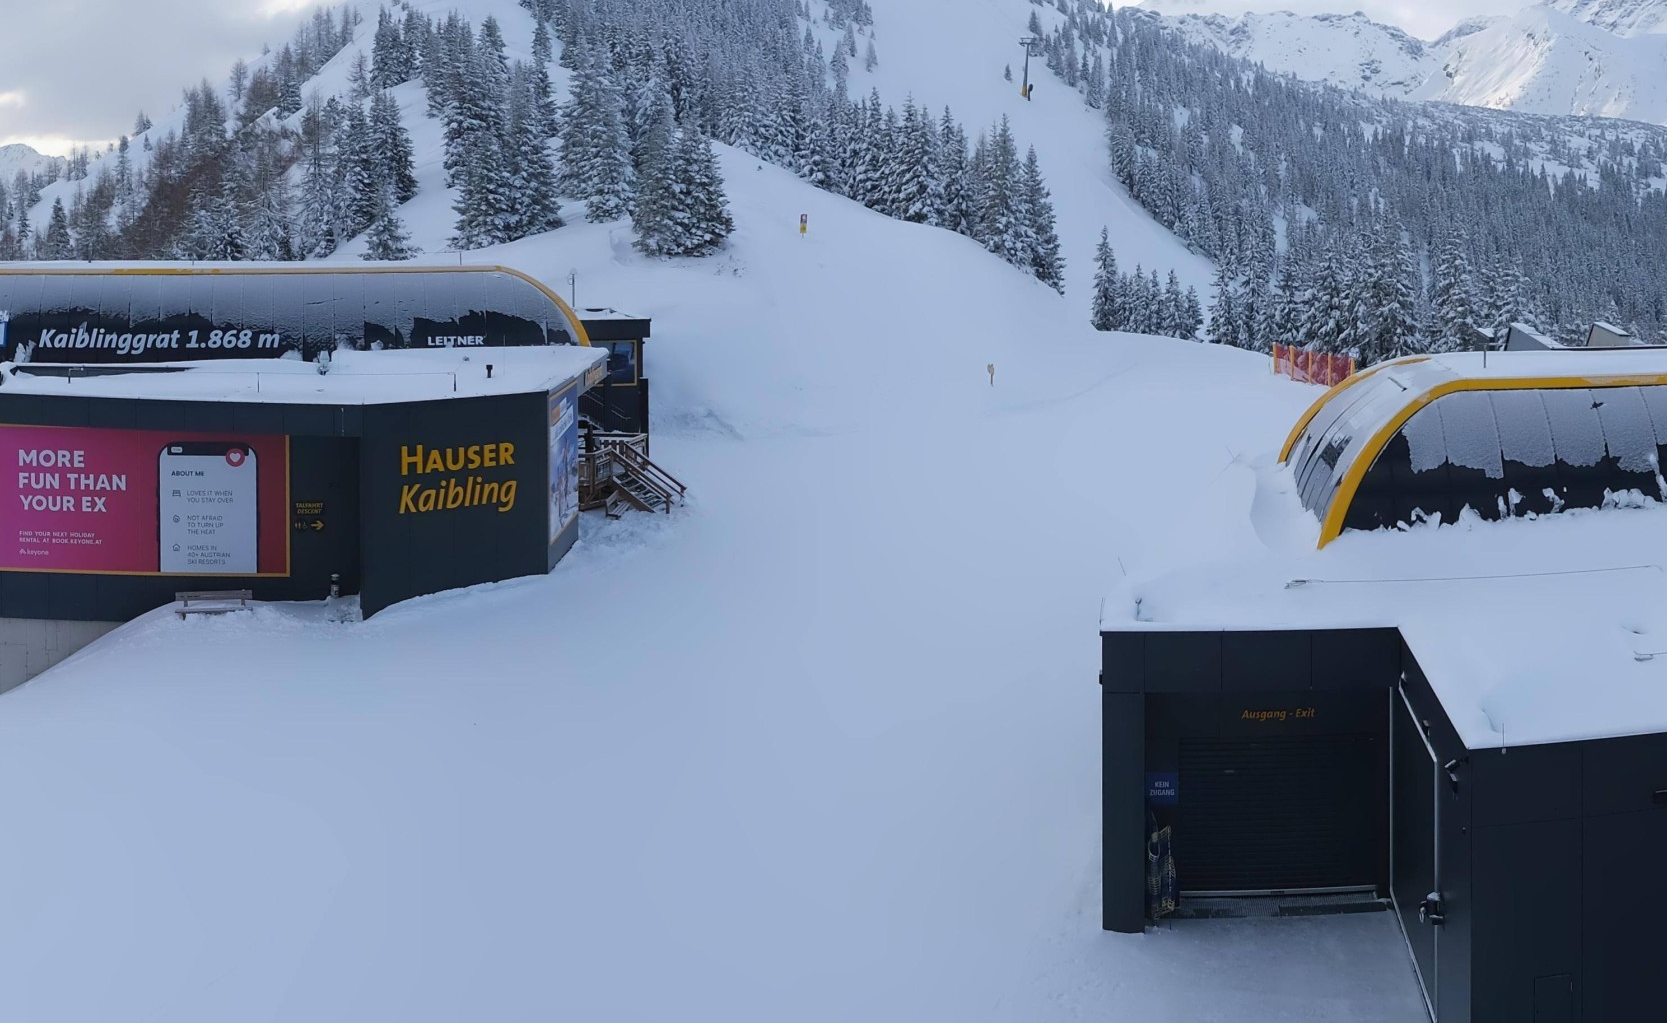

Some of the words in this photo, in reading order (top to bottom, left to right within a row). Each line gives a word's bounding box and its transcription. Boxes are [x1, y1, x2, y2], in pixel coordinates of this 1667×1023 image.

[38, 328, 180, 355] Kaiblinggrat
[185, 330, 251, 348] 1.868
[257, 333, 280, 348] m
[427, 336, 485, 346] LEITNER
[18, 449, 85, 468] MORE
[401, 442, 516, 475] HAUSER
[18, 472, 60, 489] FUN
[67, 473, 127, 491] THAN
[20, 495, 75, 512] YOUR
[81, 496, 107, 513] EX
[399, 477, 517, 514] Kaibling
[26, 548, 49, 556] keyone
[1241, 709, 1287, 722] Ausgang
[1295, 707, 1316, 718] Exit
[1149, 788, 1175, 796] ZUGANG
[1154, 780, 1170, 788] KEIN
